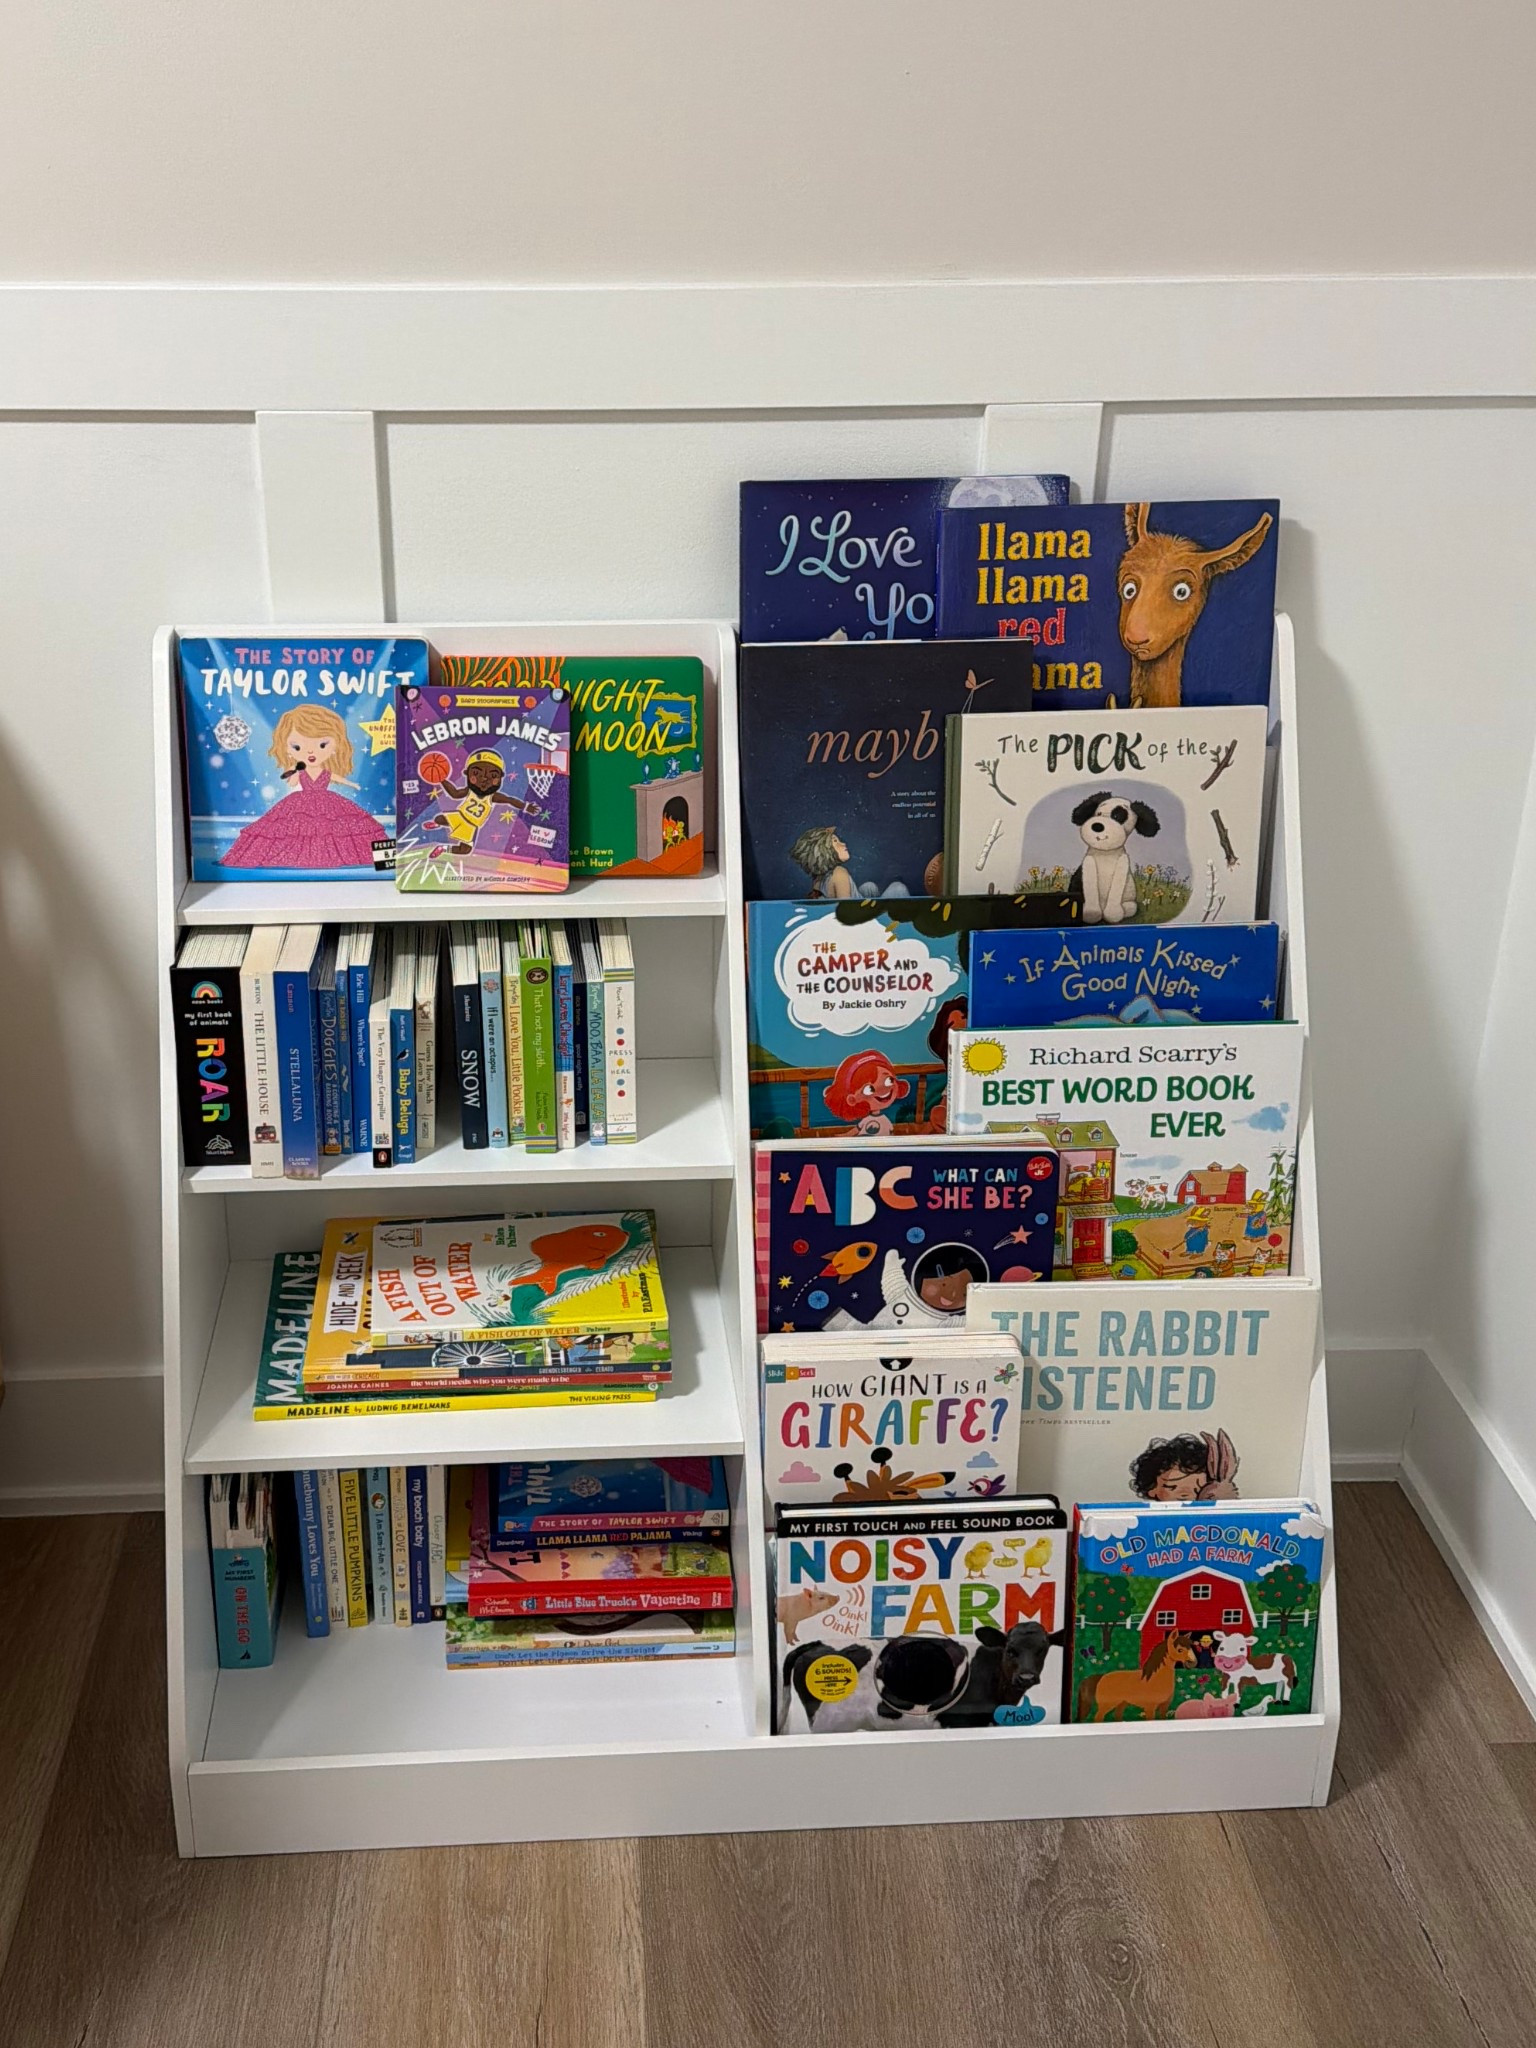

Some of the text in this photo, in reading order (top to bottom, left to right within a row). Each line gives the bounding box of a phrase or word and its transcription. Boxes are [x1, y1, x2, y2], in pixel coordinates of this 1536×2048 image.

[766, 510, 923, 583] I Love
[978, 522, 1092, 561] llama
[976, 566, 1090, 605] llama
[855, 582, 935, 640] Yo
[997, 607, 1067, 646] red
[235, 647, 375, 665] THE STORY OF
[201, 668, 415, 698] TAYLOR SWIFT
[470, 679, 665, 713] NIGHT
[412, 716, 490, 751] LEBRON
[496, 716, 562, 751] JAMES
[576, 722, 672, 752] MOON
[806, 709, 940, 779] mayb
[997, 731, 1208, 774] The PICK of the
[466, 797, 486, 818] 23
[584, 847, 614, 856] Brown
[590, 858, 613, 867] Hurd
[797, 948, 918, 978] CAMPER AND
[813, 942, 837, 954] THE
[1019, 938, 1228, 983] If Animals Kissed
[356, 973, 364, 1003] Eric Hill
[796, 972, 934, 994] THE COUNSELOR
[1061, 967, 1200, 1001] Good Night
[184, 1012, 195, 1020] my
[534, 988, 544, 1014] That's
[822, 999, 907, 1012] By Jackie Oshry
[200, 1018, 229, 1026] animals
[488, 1018, 496, 1036] were
[510, 1011, 520, 1034] Love
[534, 1016, 543, 1030] not
[254, 978, 270, 1116] BURTON THE LITTLE HOUSE
[321, 1017, 338, 1080] DOGGIES
[358, 1018, 366, 1067] Where's Spot?
[489, 1037, 496, 1046] an
[510, 1036, 520, 1056] You,
[532, 1032, 543, 1046] my
[1029, 1042, 1238, 1066] Richard Scarry's
[196, 1038, 231, 1122] ROAR
[289, 1048, 302, 1122] STELLALUNA
[376, 1027, 386, 1120] The Very Hungry Caterpillar
[461, 1050, 481, 1108] SNOW
[512, 1058, 522, 1082] Little
[397, 1068, 412, 1134] Baby Beluga
[512, 1084, 523, 1115] Pookie
[982, 1074, 1256, 1106] BEST WORD BOOK
[360, 1119, 368, 1147] WARNE
[1150, 1110, 1226, 1138] EVER
[933, 1168, 1018, 1183] WHAT CAN
[788, 1164, 918, 1226] ABC
[926, 1184, 1033, 1210] SHE BE?
[413, 1255, 456, 1316] OUT OF
[448, 1242, 481, 1302] WATER
[328, 1255, 364, 1326] HIDE AND SEEK
[378, 1269, 414, 1312] FISH
[266, 1253, 321, 1402] MADELINE
[400, 1310, 428, 1322] A
[991, 1310, 1270, 1357] THE RABBIT
[326, 1382, 360, 1390] JOANNA
[584, 1394, 611, 1402] VIKING
[812, 1374, 987, 1398] HOW GIANT IS A
[1021, 1366, 1217, 1412] ISTENED
[287, 1402, 451, 1417] MADELINE by LUDWIG BEMELMANS
[780, 1398, 1009, 1450] GIRAFFE?
[302, 1470, 317, 1522] omebunny
[412, 1479, 424, 1548] my beach baby
[538, 1516, 676, 1528] THE STORY OF TAYLOR SWIFT
[790, 1515, 1055, 1534] MY FIRST TOUCH AND FEEL SOUND BOOK
[308, 1525, 320, 1554] Loves
[344, 1478, 363, 1602] FIVE LITTLE PUMPKINS
[536, 1531, 672, 1546] LLAMA LLAMA RED PAJAMA
[1100, 1524, 1301, 1565] OLD MACDONALD
[310, 1556, 320, 1576] You
[789, 1536, 966, 1584] NOISY
[1147, 1546, 1254, 1568] HAD A FARM
[545, 1597, 573, 1609] Little
[574, 1596, 596, 1608] Blue
[598, 1596, 638, 1608] Truck's
[640, 1594, 700, 1608] Valentine
[838, 1605, 868, 1623] Oink!
[870, 1582, 1056, 1638] FARM
[822, 1614, 860, 1638] Oink!
[1002, 1708, 1036, 1723] Moo!
